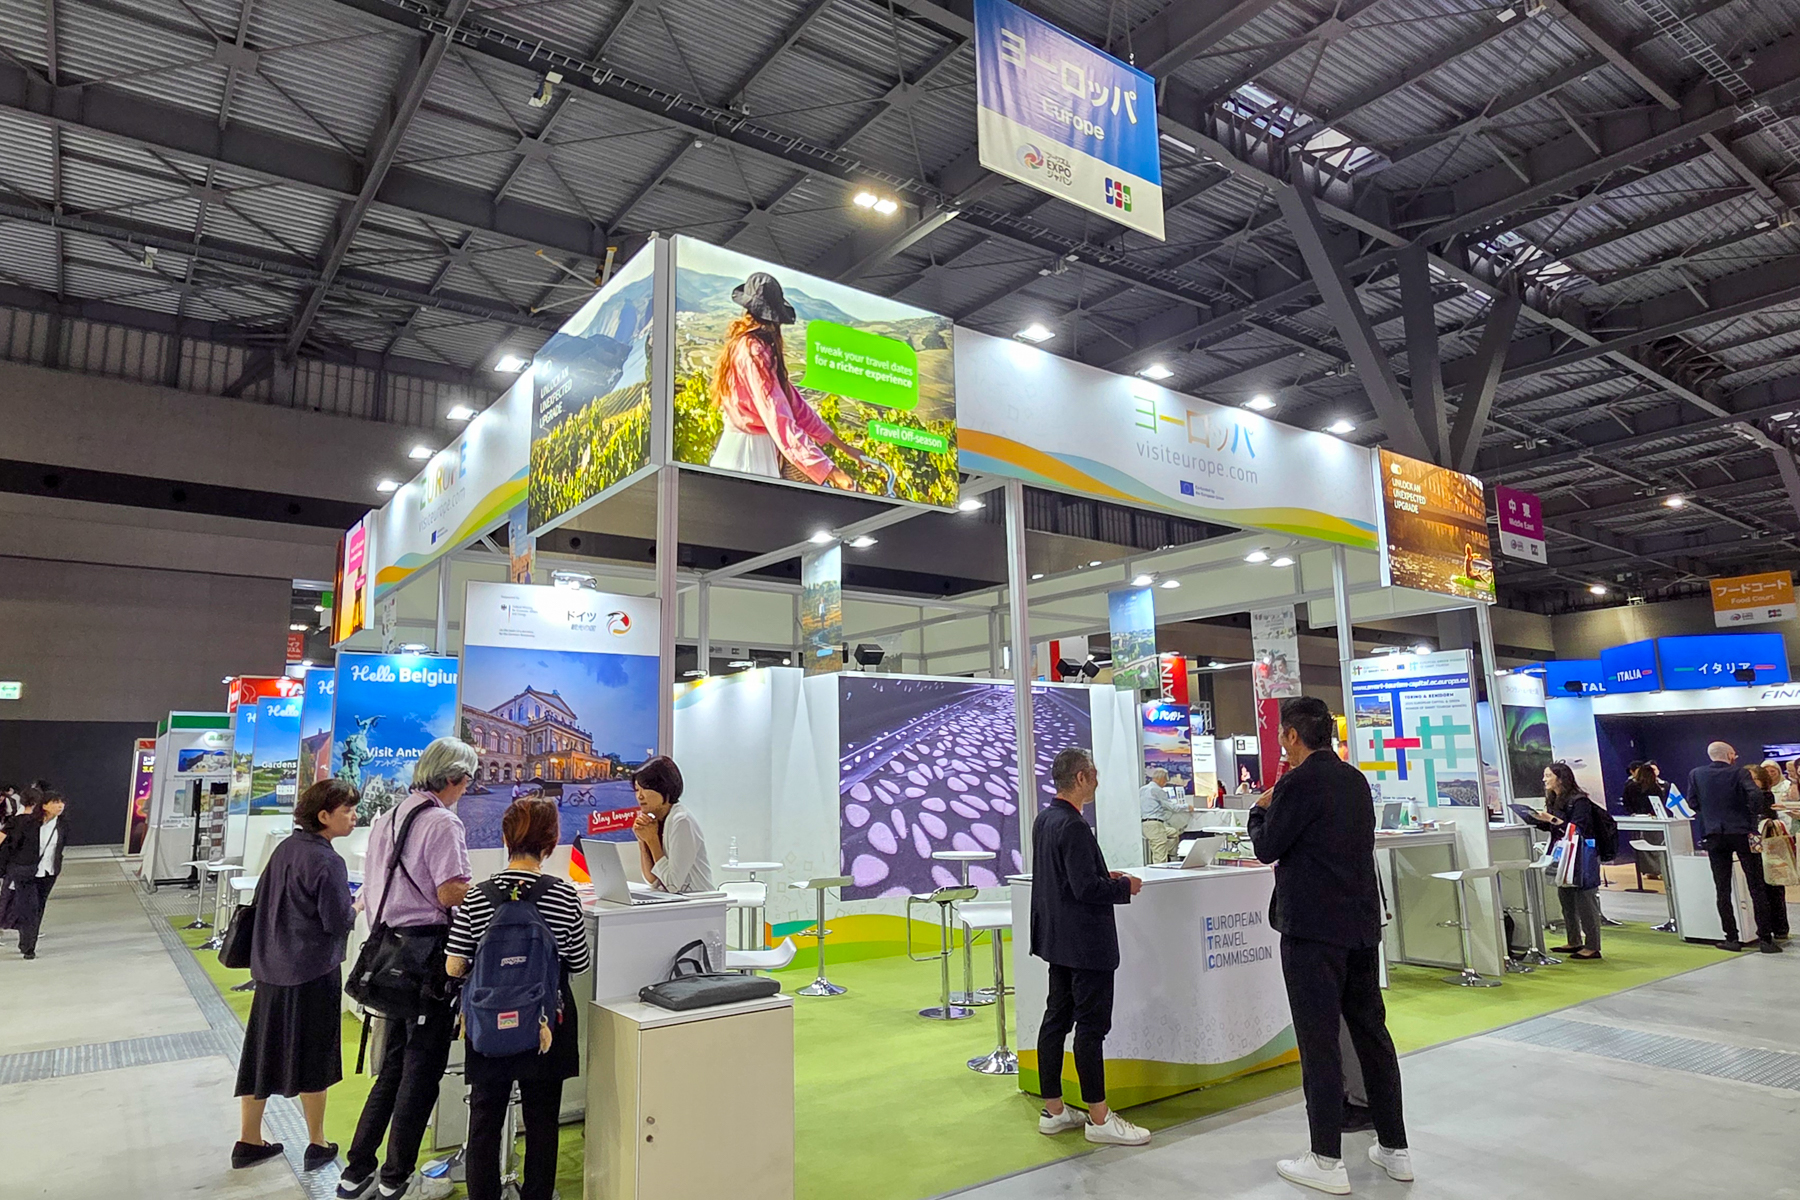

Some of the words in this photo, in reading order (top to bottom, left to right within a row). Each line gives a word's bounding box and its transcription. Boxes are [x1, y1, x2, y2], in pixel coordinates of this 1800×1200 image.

[1001, 28, 1138, 125] ヨーロッパ
[1041, 98, 1105, 140] Europe
[1046, 159, 1072, 178] EXPO
[814, 341, 843, 358] Tweak
[844, 349, 864, 364] your
[866, 355, 889, 370] travel
[890, 363, 913, 377] dates
[814, 354, 828, 366] for
[829, 360, 835, 369] a
[836, 361, 864, 376] richer
[865, 369, 913, 389] experience
[1134, 395, 1256, 459] ヨーロッパ
[874, 423, 900, 440] Travel
[901, 430, 943, 449] Off-season
[1136, 440, 1258, 485] visiteurope.com
[1392, 477, 1412, 491] UNLOCK
[1412, 484, 1422, 493] AN
[1393, 488, 1427, 505] UNEXPECTED
[1394, 500, 1420, 514] UPGRADE
[1716, 579, 1787, 596] フードコート
[1752, 594, 1775, 603] Court
[567, 610, 596, 622] ドイツ
[350, 665, 396, 682] Hello
[1617, 669, 1642, 682] ITALIA
[267, 704, 299, 717] Hello
[366, 746, 394, 758] Visit
[262, 760, 297, 768] Gardens
[592, 810, 611, 825] Stay
[612, 811, 635, 821] longer
[1206, 911, 1262, 931] EUROPEAN
[1207, 931, 1248, 950] TRAVEL
[1209, 946, 1272, 969] COMMISSION
